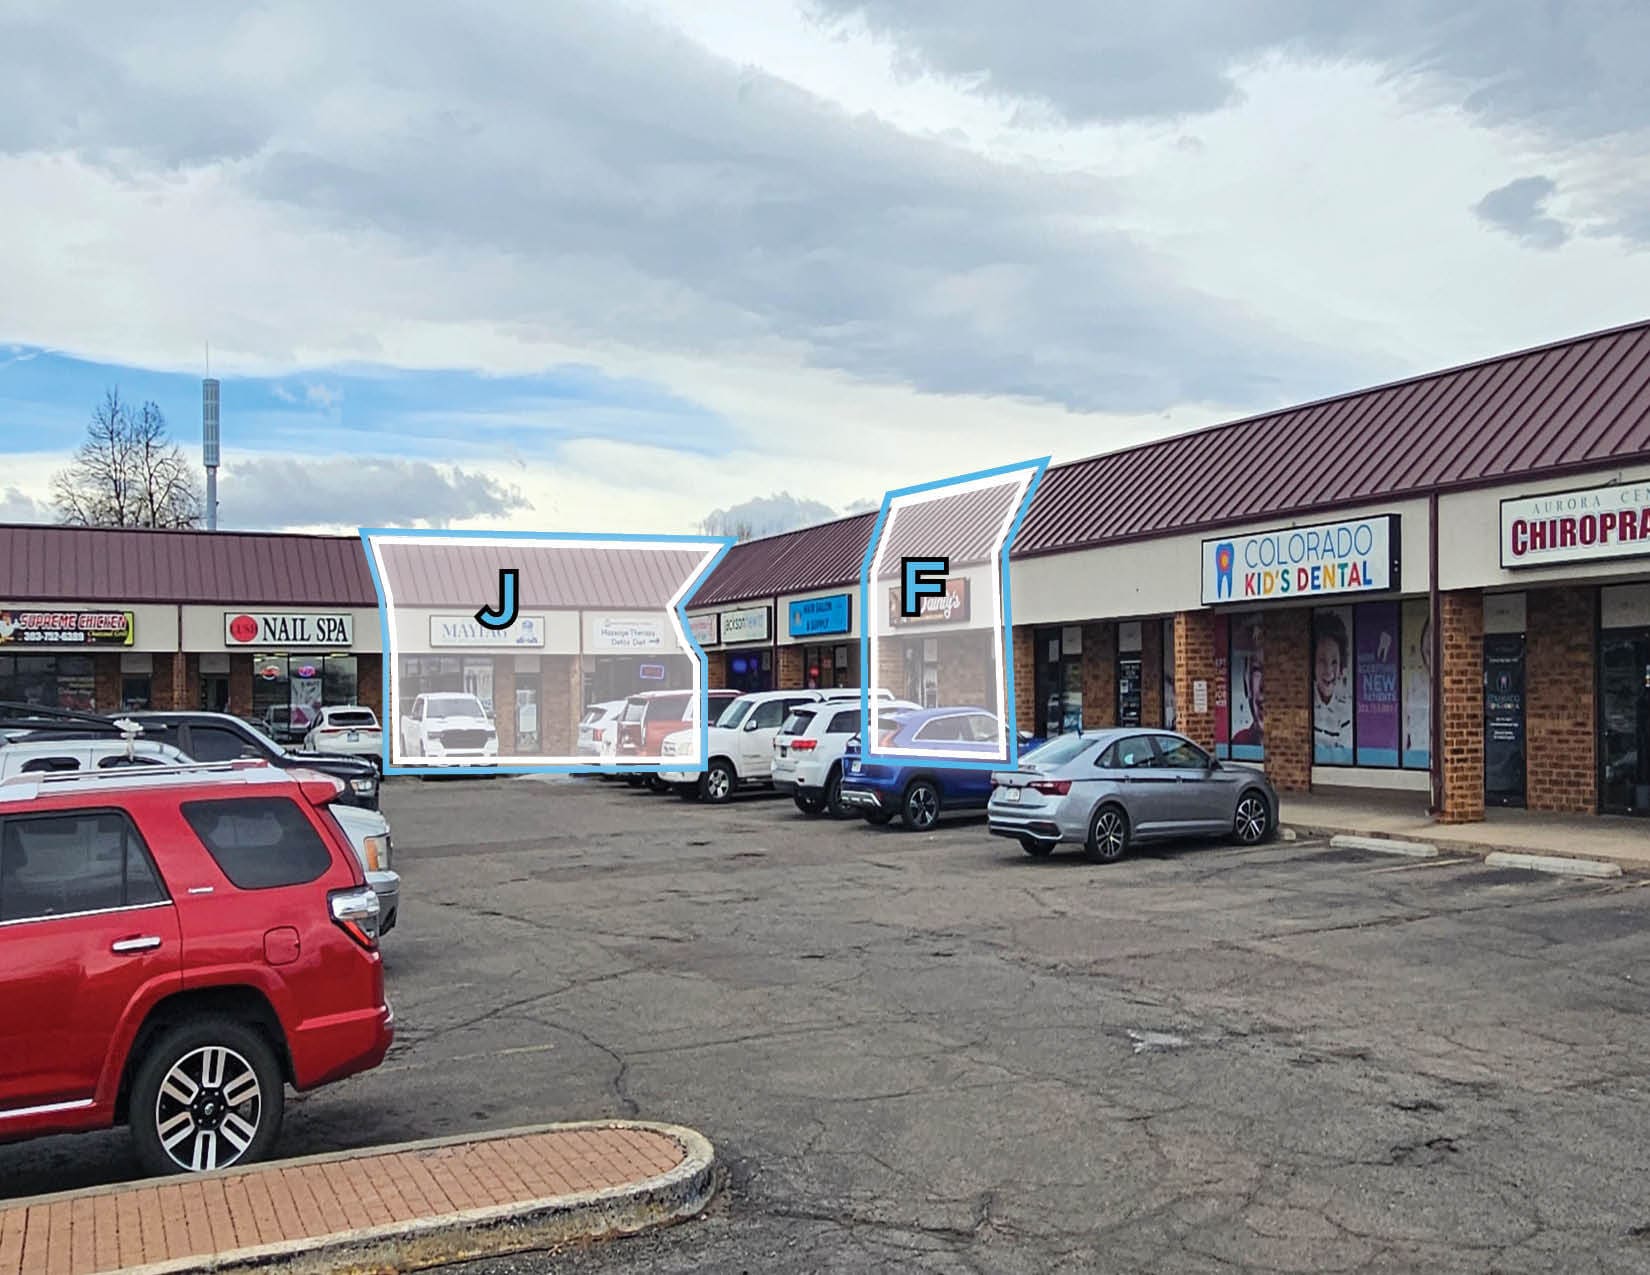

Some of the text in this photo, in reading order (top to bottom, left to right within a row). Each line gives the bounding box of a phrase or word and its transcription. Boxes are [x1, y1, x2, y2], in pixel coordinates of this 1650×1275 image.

[1532, 495, 1601, 515] AURORA
[1245, 524, 1373, 569] COLORADO
[1245, 561, 1373, 596] KID'S DENTAL
[20, 613, 127, 630] SUPREME CHICKEN
[262, 617, 311, 641] NAIL
[316, 617, 348, 642] SPA
[1363, 672, 1396, 691] NEW
